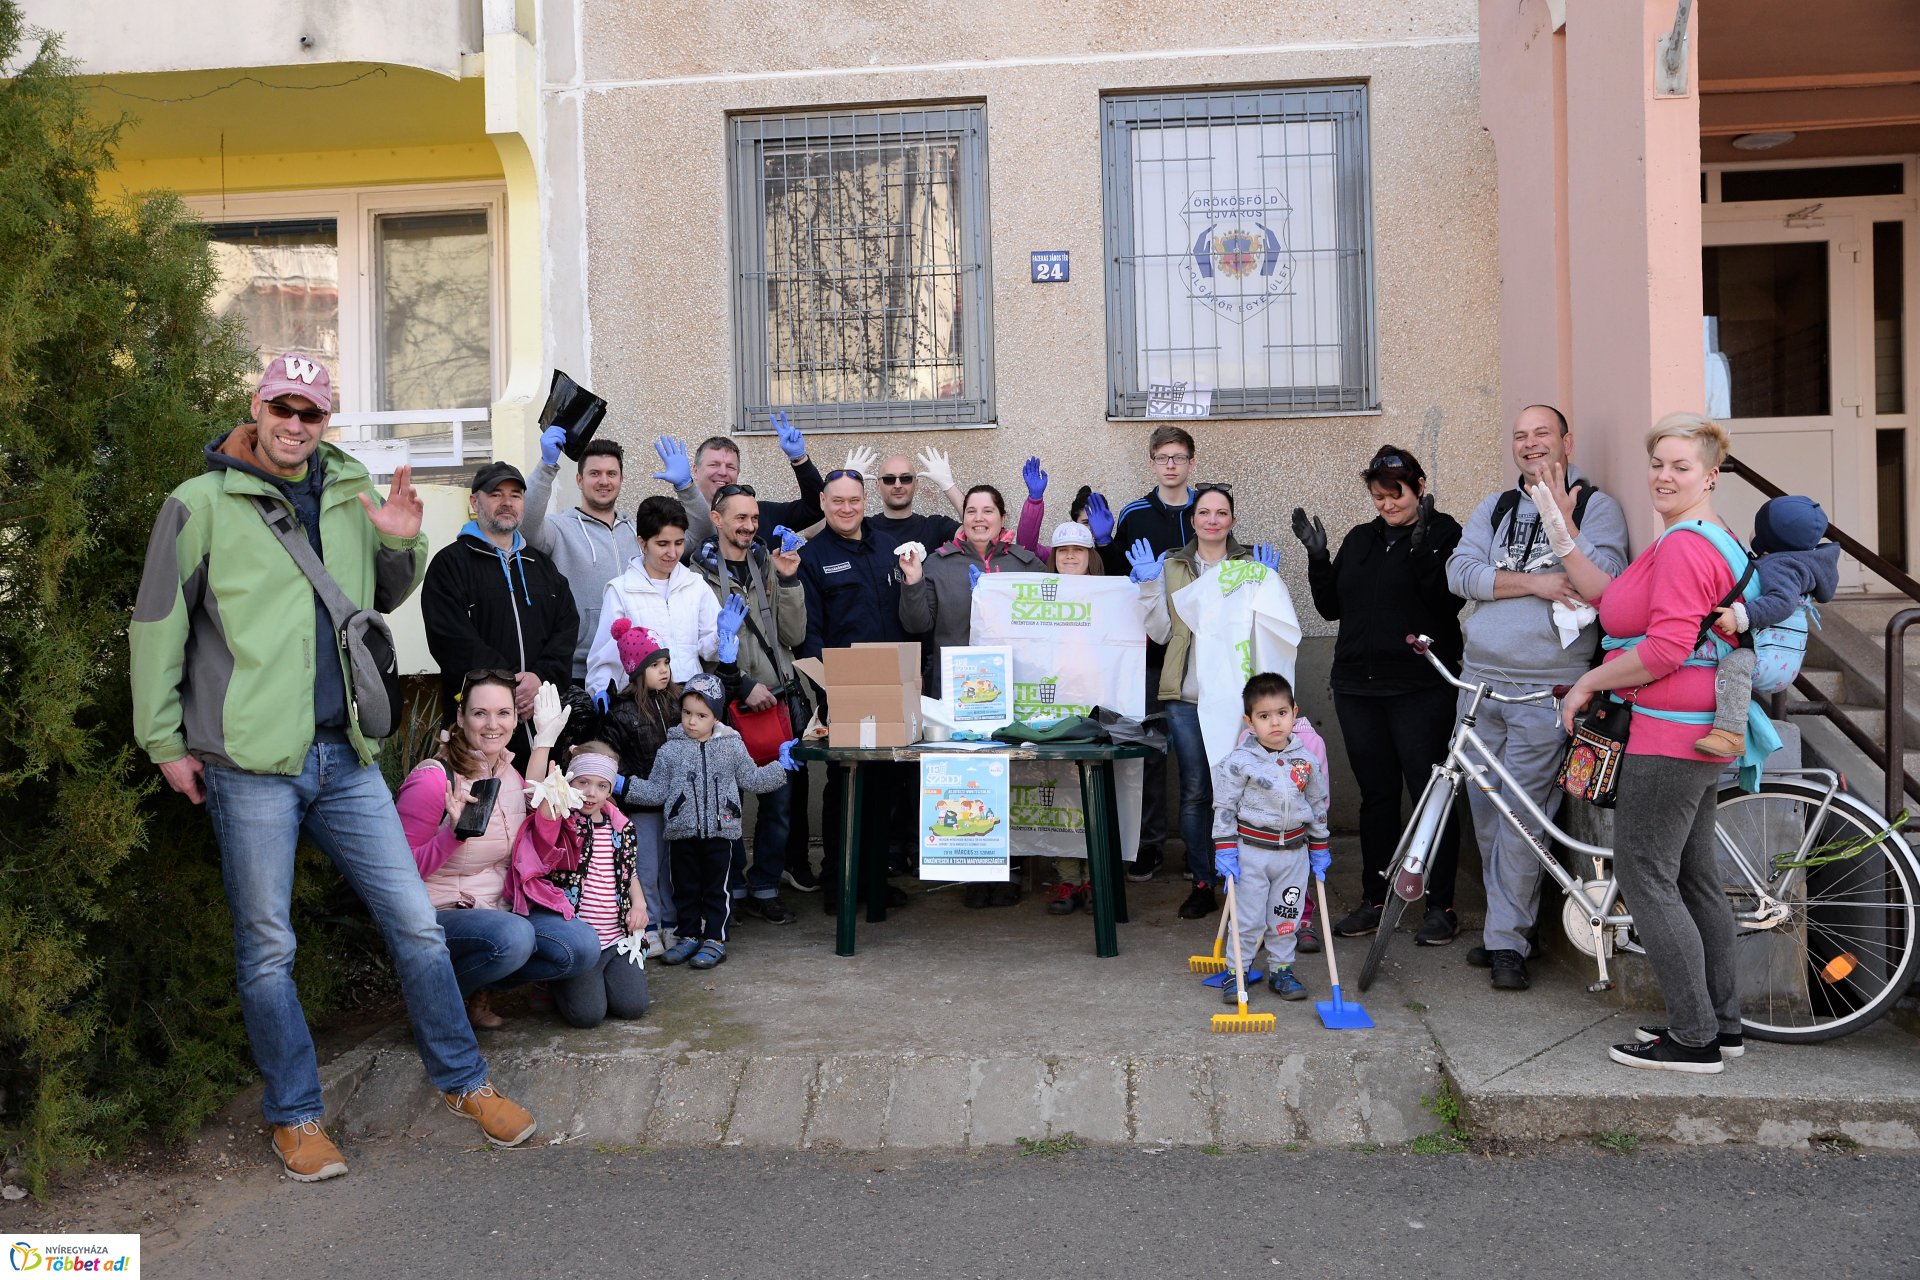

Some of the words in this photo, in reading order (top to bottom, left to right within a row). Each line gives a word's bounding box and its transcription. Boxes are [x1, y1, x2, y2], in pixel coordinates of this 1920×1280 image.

[1193, 195, 1278, 208] ÖRÖKÖSFÖLD
[1037, 263, 1063, 280] 24
[284, 358, 320, 385] W
[1012, 583, 1042, 601] TE
[1011, 601, 1091, 621] SZEDD!
[1013, 683, 1040, 703] TE
[926, 764, 940, 775] TE
[926, 775, 962, 786] SZEDD!
